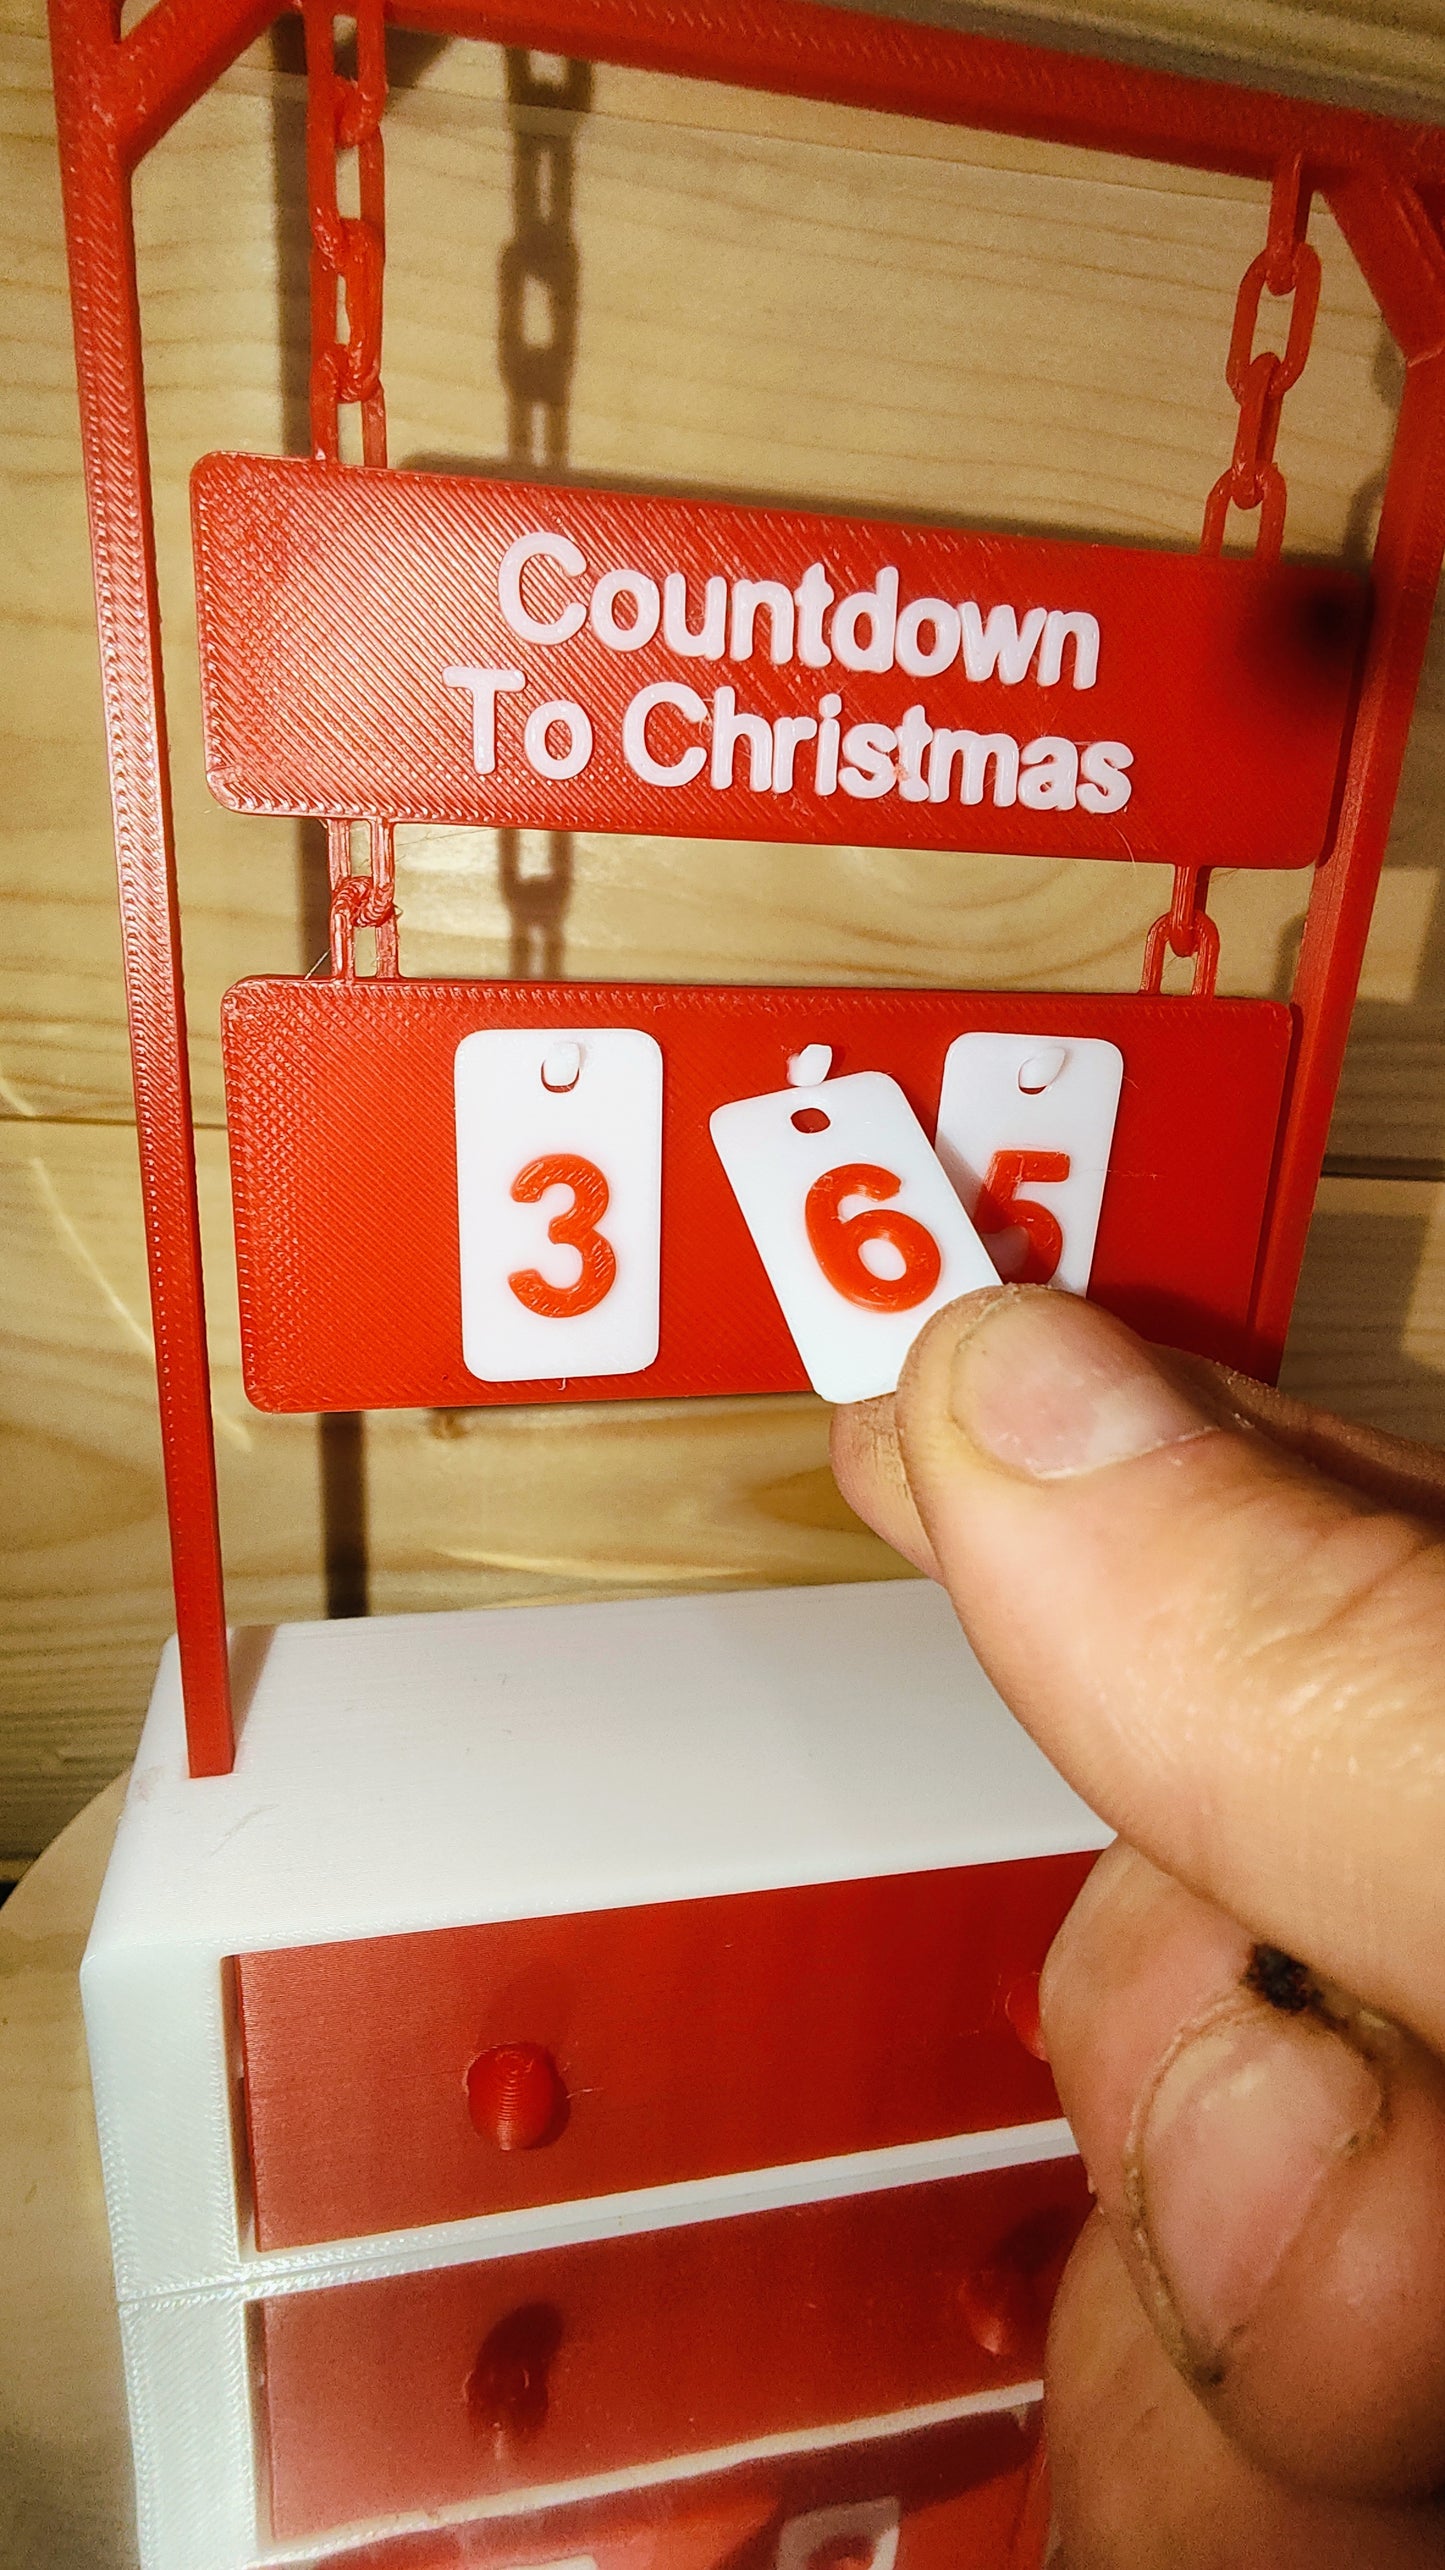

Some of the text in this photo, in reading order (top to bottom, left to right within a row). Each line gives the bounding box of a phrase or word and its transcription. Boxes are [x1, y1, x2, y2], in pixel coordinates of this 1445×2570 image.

[498, 531, 1099, 690] Countdown
[442, 665, 1135, 816] To Christmas
[508, 1149, 1072, 1319] 3 6 5
